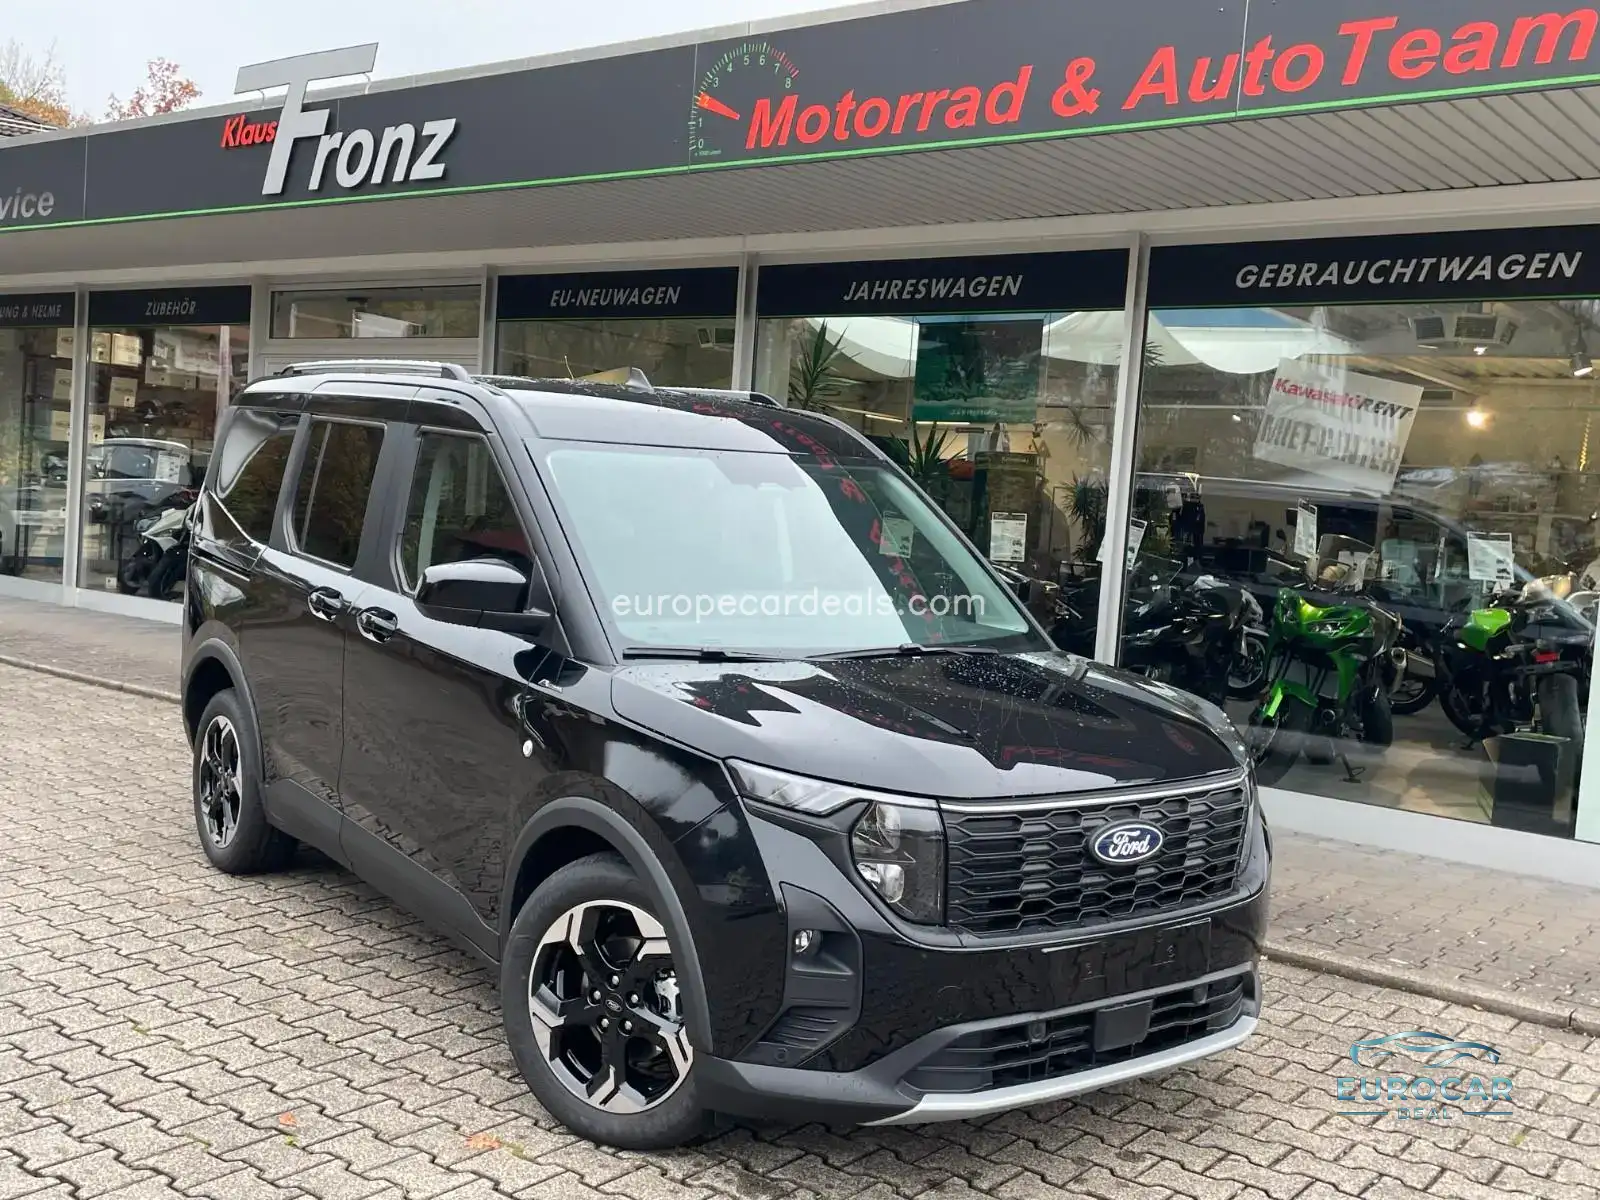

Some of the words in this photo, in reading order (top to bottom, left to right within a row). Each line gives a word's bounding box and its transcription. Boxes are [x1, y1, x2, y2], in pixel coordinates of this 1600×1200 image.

[745, 65, 1033, 150] Motorrad
[1051, 57, 1102, 118] &
[220, 112, 278, 148] Klaus
[234, 42, 457, 195] Fronz
[1235, 251, 1583, 289] GEBRAUCHTWAGEN
[549, 286, 681, 307] EU-NEUWAGEN
[843, 274, 1023, 301] JAHRESWAGEN
[32, 304, 62, 319] HELME
[145, 296, 197, 316] ZUBEHÖR
[1108, 829, 1151, 857] Ford
